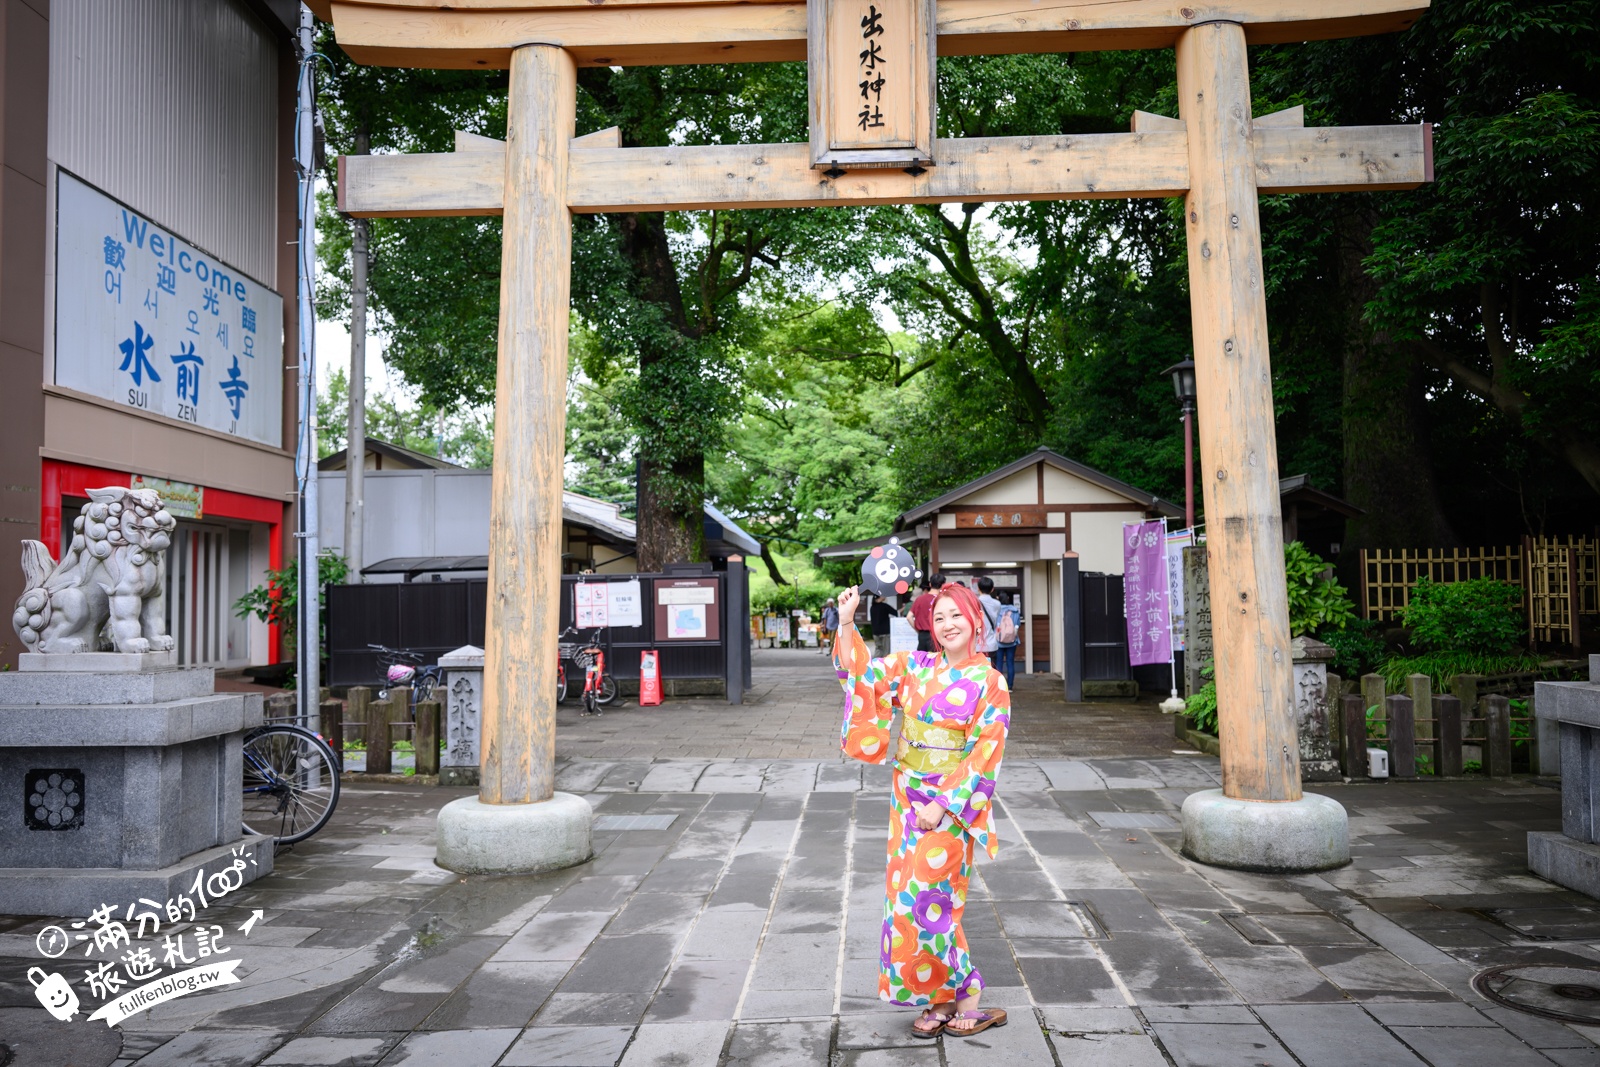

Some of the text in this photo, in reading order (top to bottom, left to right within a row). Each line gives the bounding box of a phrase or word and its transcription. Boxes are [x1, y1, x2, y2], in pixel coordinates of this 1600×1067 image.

[858, 5, 886, 131] 出水神社
[121, 209, 247, 302] Welcome
[118, 320, 250, 420] 水前寺
[128, 388, 237, 435] SUI ZEN JI
